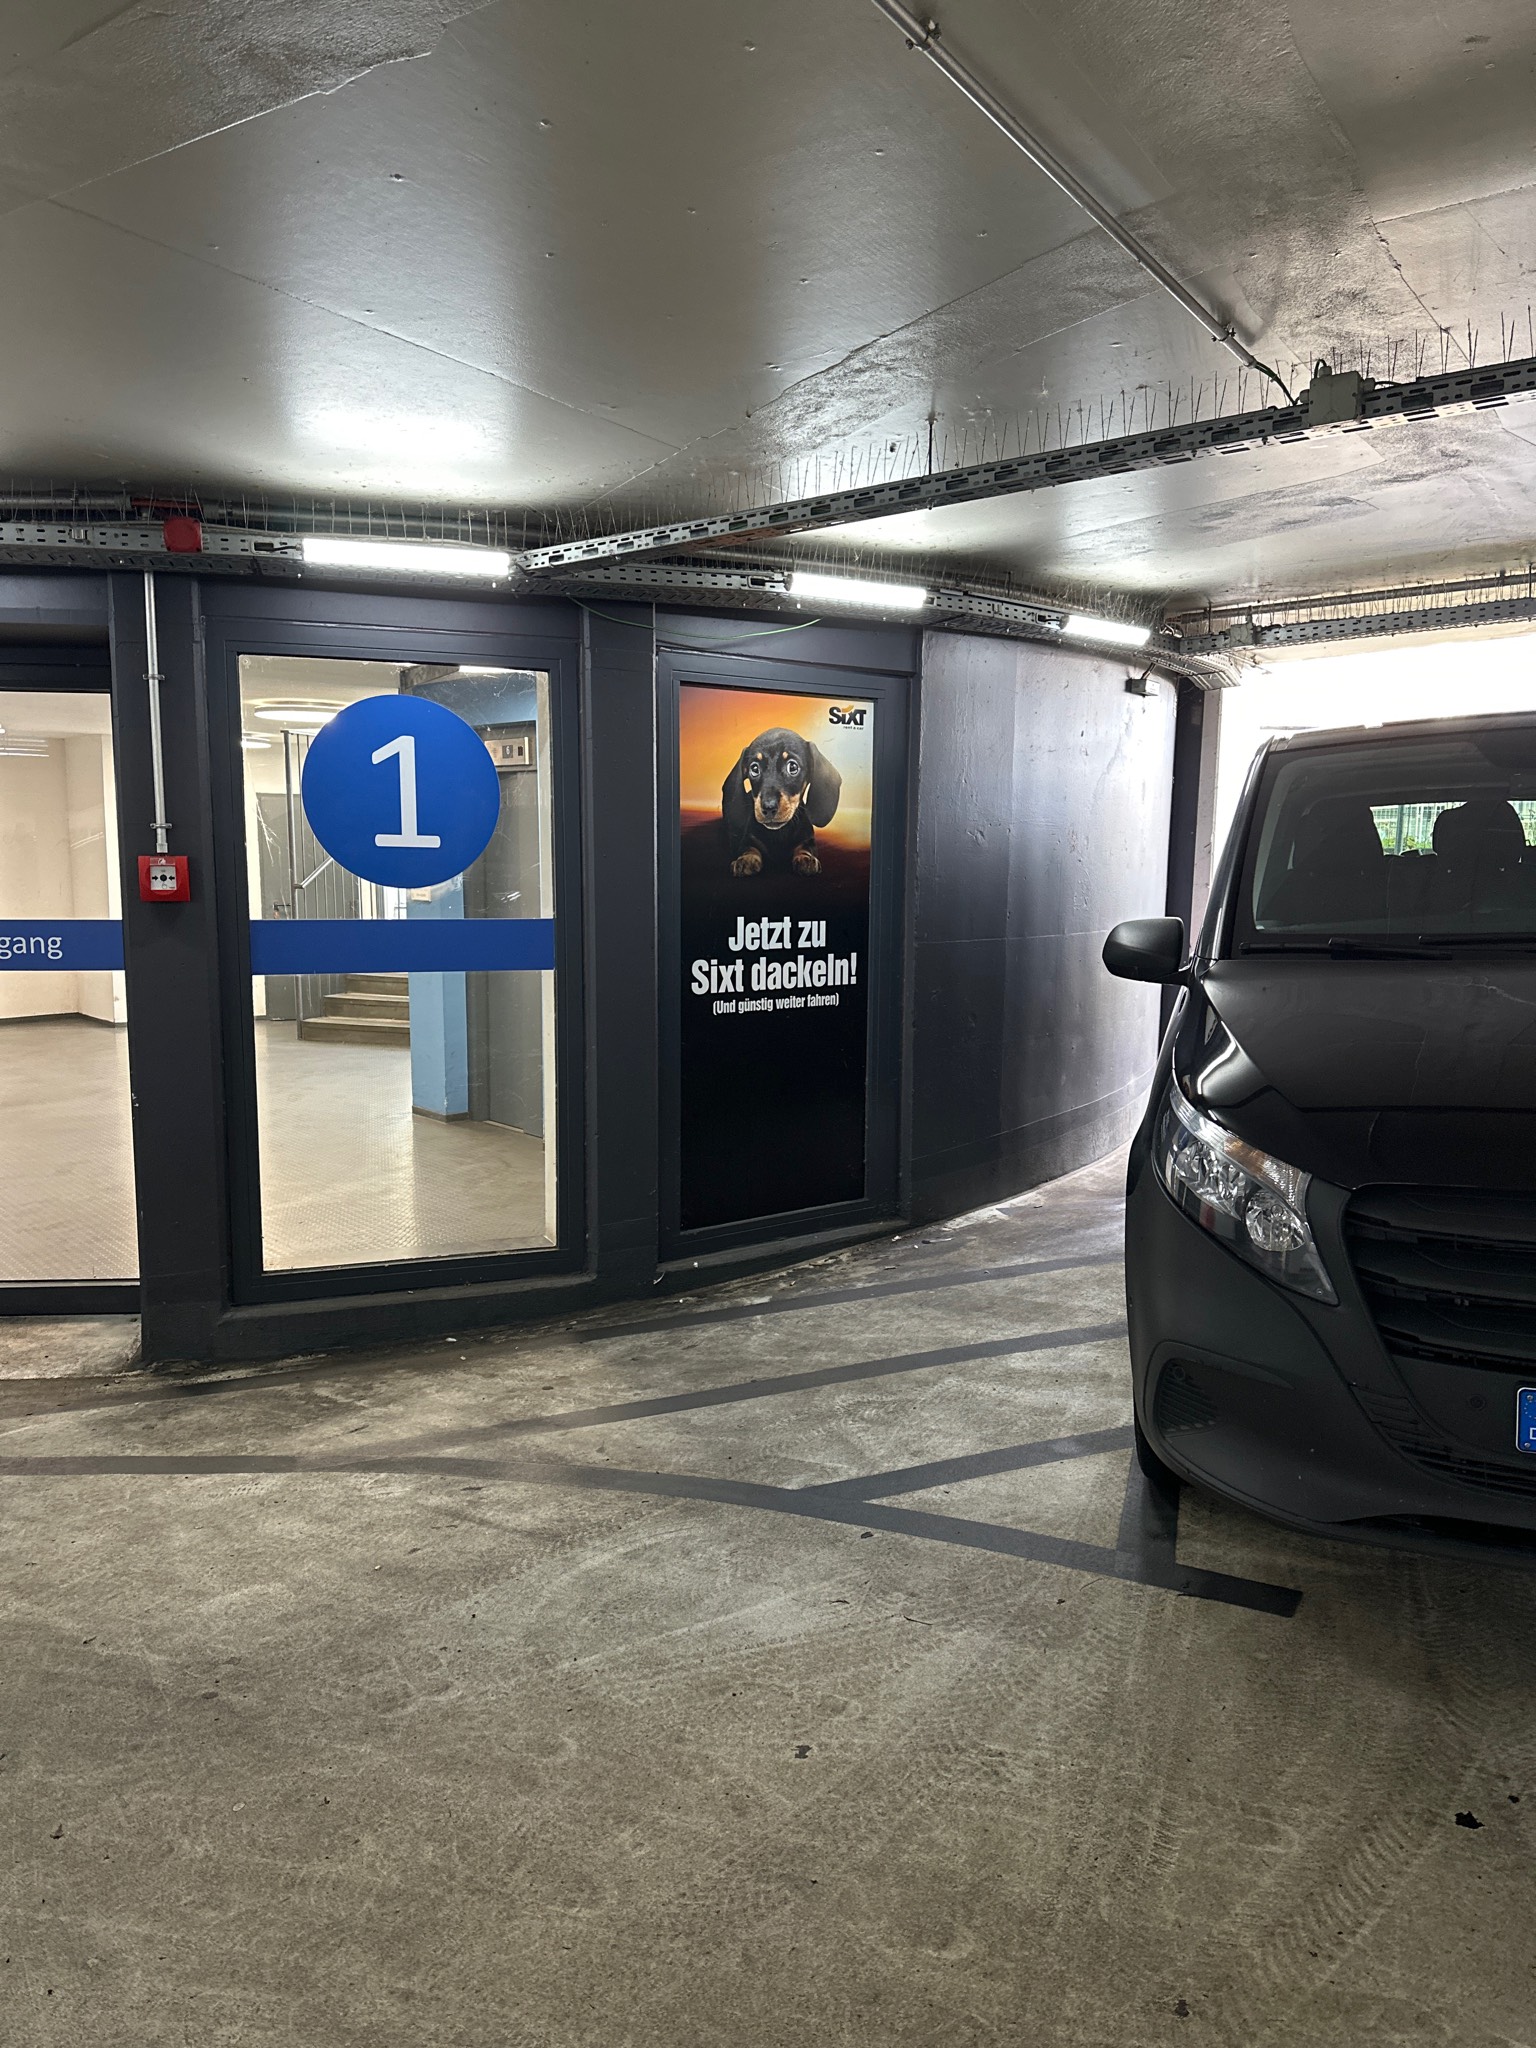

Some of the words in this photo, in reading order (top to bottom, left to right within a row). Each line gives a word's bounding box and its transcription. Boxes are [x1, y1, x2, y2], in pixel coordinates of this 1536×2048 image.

[372, 735, 441, 848] 1
[728, 916, 792, 952] Jetzt
[798, 920, 826, 948] zu
[691, 959, 744, 995] Sixt
[751, 952, 857, 992] dackeln!
[713, 1000, 736, 1016] (Und
[738, 998, 774, 1014] günstig
[775, 995, 806, 1010] weiter
[807, 992, 840, 1008] fahren)
